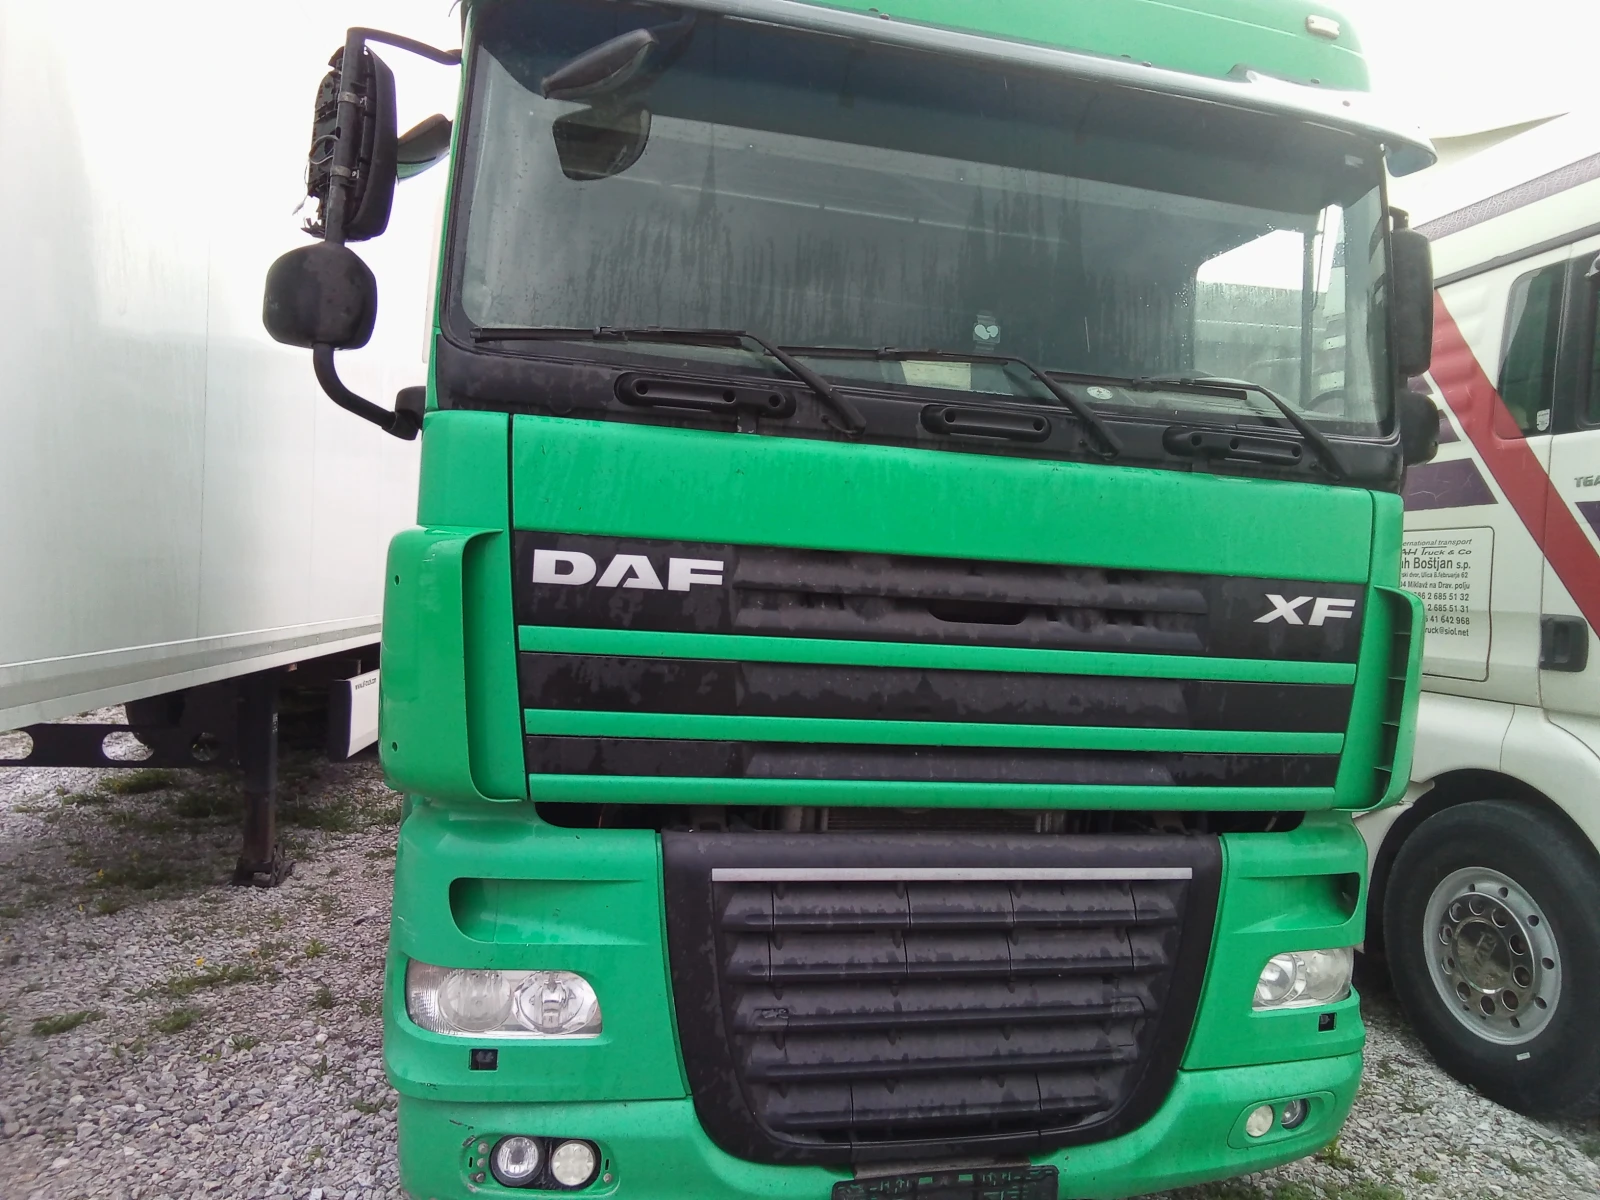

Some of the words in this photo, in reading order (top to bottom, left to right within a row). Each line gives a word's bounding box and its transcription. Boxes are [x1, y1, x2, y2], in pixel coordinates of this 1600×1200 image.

[1438, 538, 1472, 546] transport
[1421, 546, 1447, 556] Truck
[1413, 557, 1453, 571] Boštjan
[1456, 562, 1471, 570] s.p.
[533, 549, 724, 592] DAF
[1407, 580, 1428, 588] Miklavž
[1438, 581, 1454, 589] Drav.
[1454, 581, 1471, 590] polju
[1427, 592, 1432, 600] 2
[1433, 592, 1447, 601] 685
[1448, 592, 1458, 601] 51
[1459, 592, 1470, 602] 32
[1254, 593, 1356, 625] XF
[1427, 603, 1432, 611] 2
[1433, 603, 1447, 612] 685
[1448, 604, 1458, 612] 51
[1459, 605, 1469, 613] 31
[1429, 615, 1439, 623] 41
[1440, 615, 1455, 624] 642
[1455, 616, 1470, 625] 968
